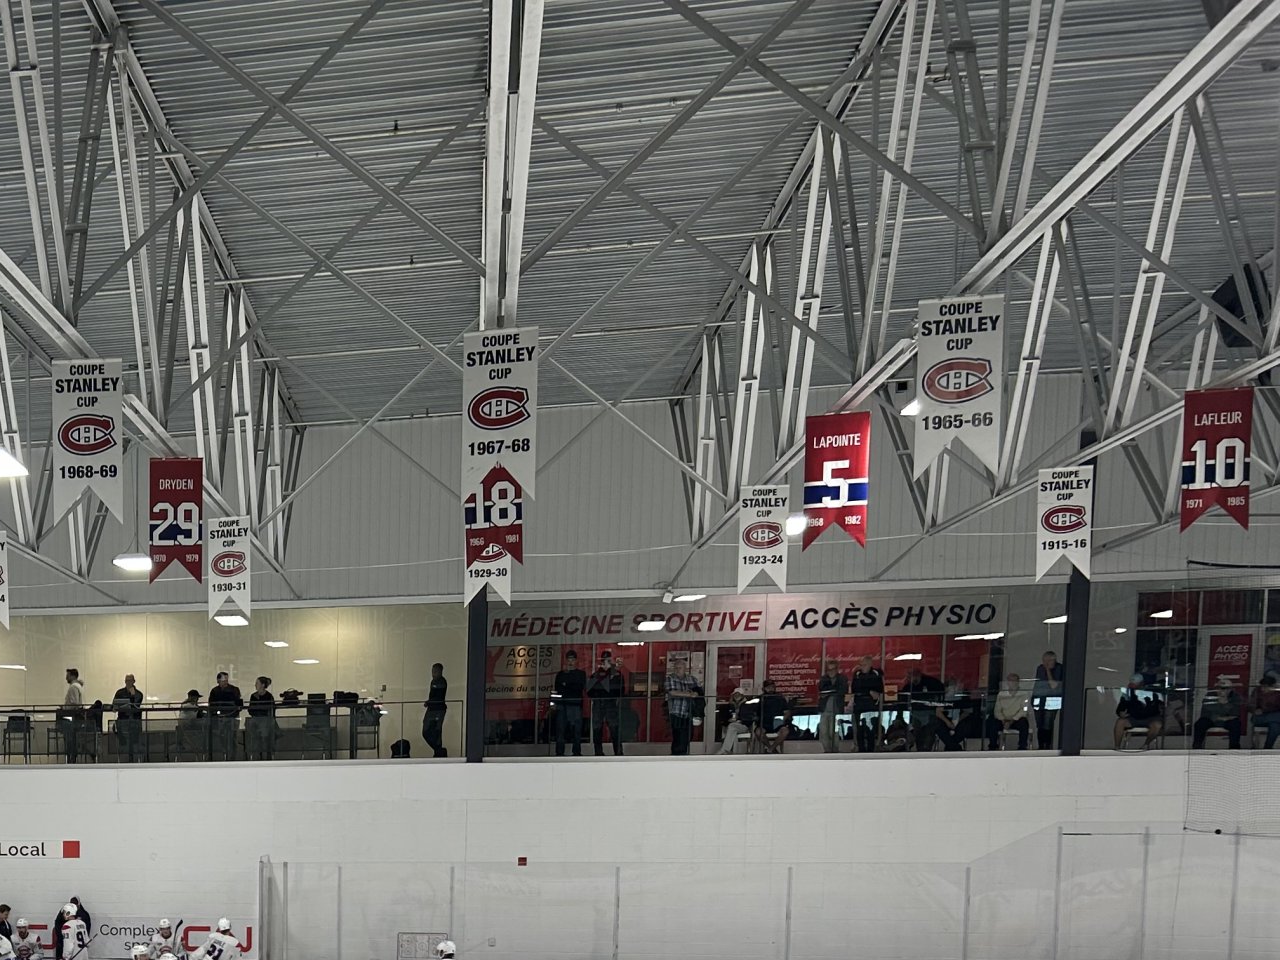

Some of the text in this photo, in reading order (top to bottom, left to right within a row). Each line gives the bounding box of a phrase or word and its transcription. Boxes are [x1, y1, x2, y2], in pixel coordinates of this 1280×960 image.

[939, 302, 983, 317] COUPE
[921, 315, 1000, 337] STANLEY
[482, 333, 521, 348] COUPE
[946, 337, 973, 351] CUP
[466, 346, 536, 368] STANLEY
[69, 364, 105, 376] COUPE
[488, 367, 512, 381] CUP
[55, 377, 120, 394] STANLEY
[77, 396, 98, 408] CUP
[922, 411, 993, 431] 1965-66
[1194, 411, 1242, 426] LAFLEUR
[468, 438, 531, 456] 1967-68
[813, 433, 861, 449] LAPOINTE
[1189, 437, 1246, 490] 10
[59, 464, 118, 479] 1968-69
[1051, 470, 1080, 480] COUPE
[159, 479, 194, 490] DRYDEN
[822, 459, 850, 508] 5
[1040, 479, 1091, 492] STANLEY
[752, 489, 778, 497] COUPE
[1056, 492, 1074, 501] CUP
[470, 480, 517, 529] 18
[742, 497, 788, 509] STANLEY
[1186, 499, 1203, 508] 1971
[756, 510, 772, 518] CUP
[845, 515, 861, 525] 1982
[152, 502, 200, 546] 29
[218, 520, 240, 528] COUPE
[209, 527, 249, 540] STANLEY
[222, 540, 236, 548] CUP
[1041, 538, 1087, 551] 1915-16
[742, 554, 783, 565] 1923-24
[468, 568, 508, 578] 1929-30
[211, 581, 247, 592] 1930-31
[490, 612, 623, 637] MÉDECINE
[780, 603, 878, 630] ACCÈS
[884, 603, 996, 627] PHYSIO
